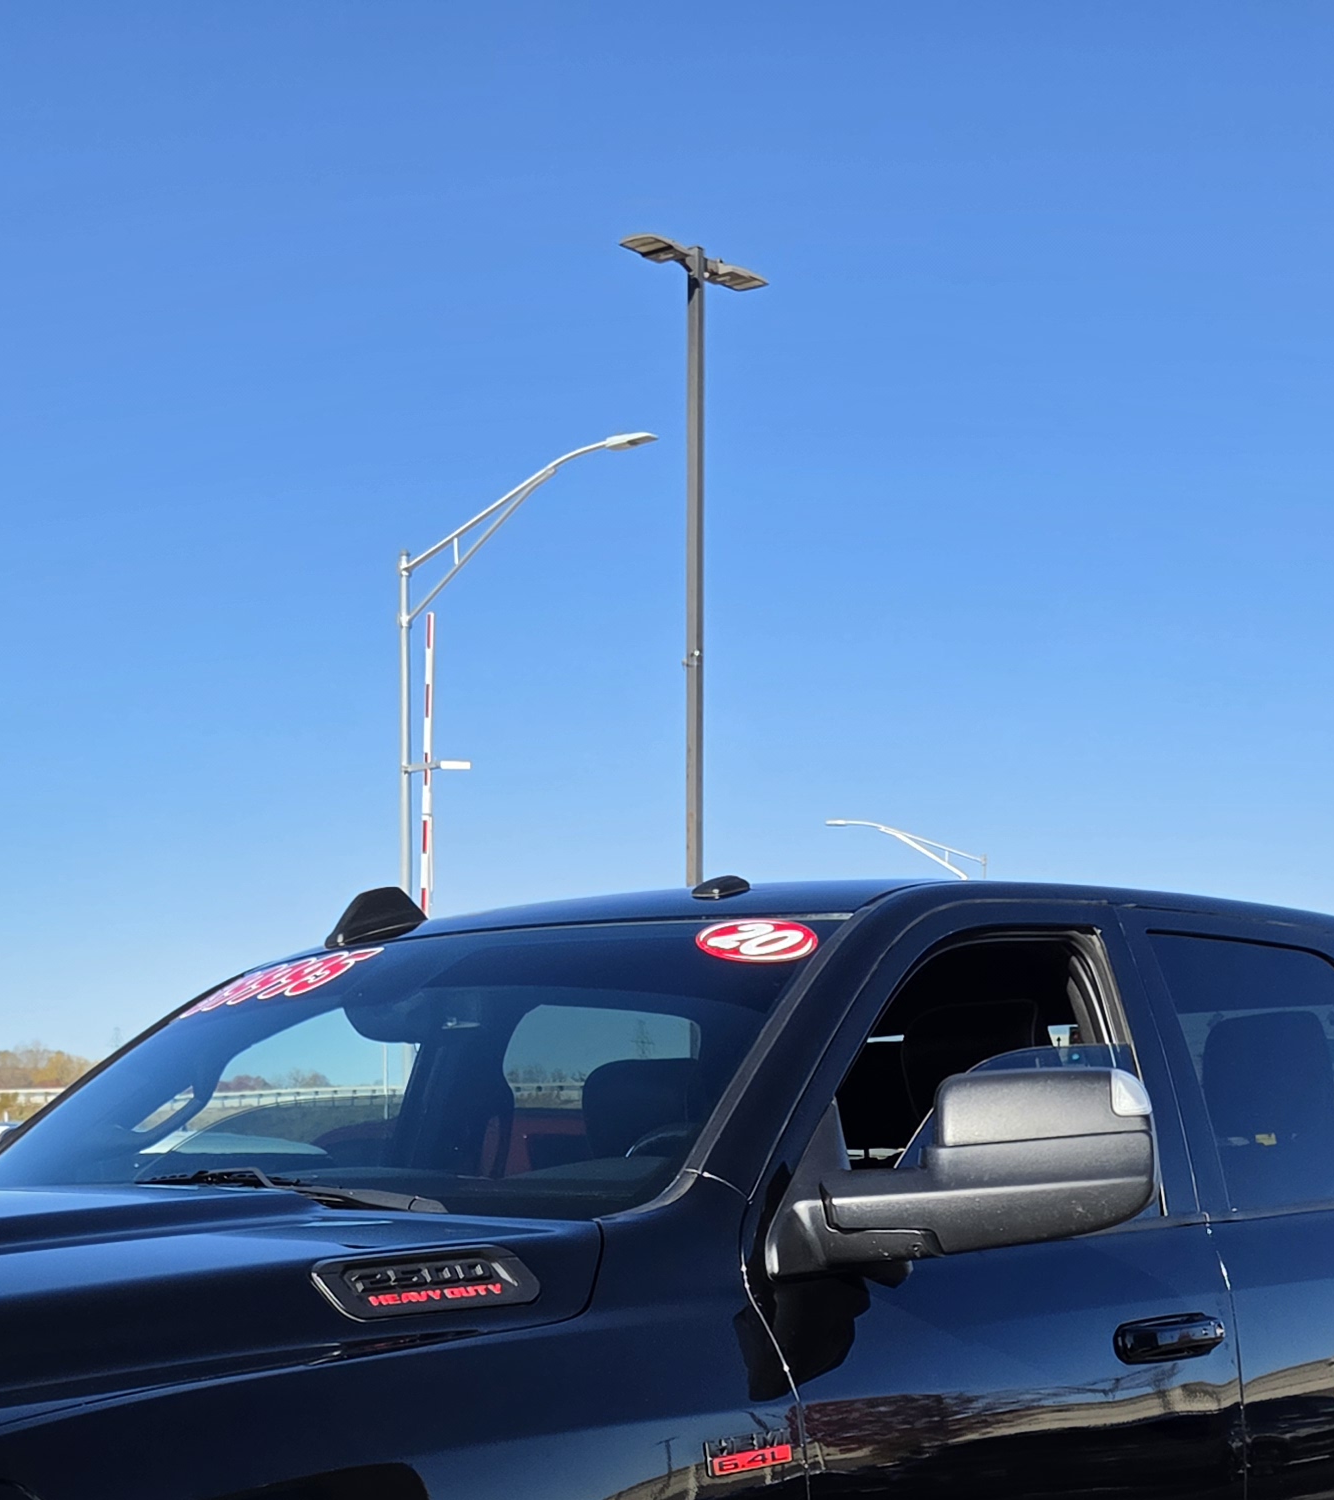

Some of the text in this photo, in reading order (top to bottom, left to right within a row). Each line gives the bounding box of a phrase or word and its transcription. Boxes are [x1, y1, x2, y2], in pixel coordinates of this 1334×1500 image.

[707, 923, 805, 956] 20
[351, 1259, 495, 1293] 2500
[368, 1283, 502, 1307] HEAVY DUTY
[704, 1428, 791, 1459] HEMI
[717, 1450, 788, 1472] 6.4L
